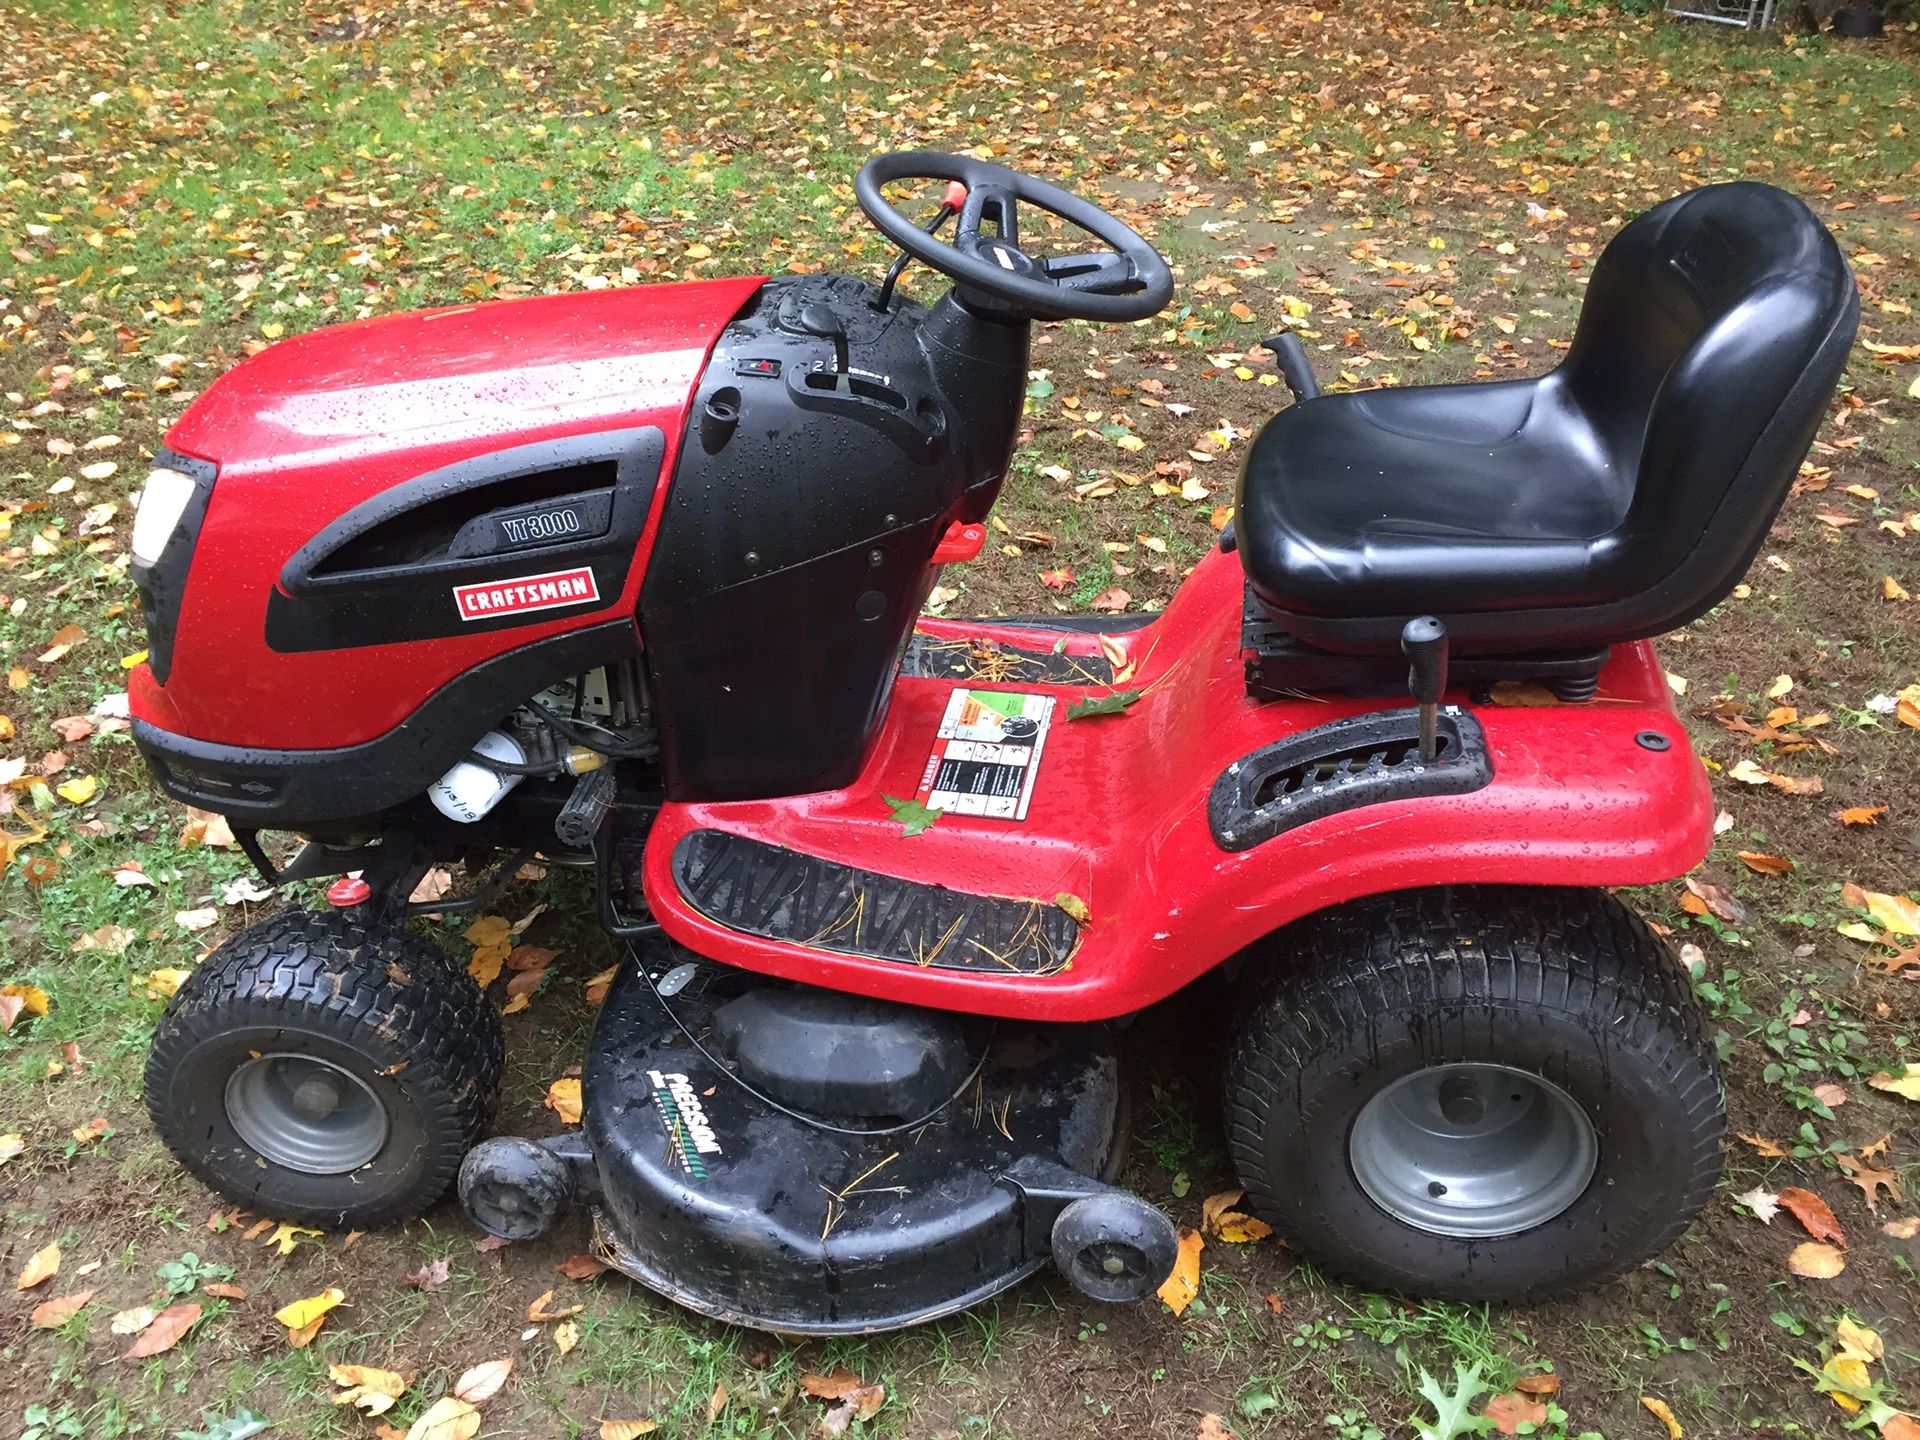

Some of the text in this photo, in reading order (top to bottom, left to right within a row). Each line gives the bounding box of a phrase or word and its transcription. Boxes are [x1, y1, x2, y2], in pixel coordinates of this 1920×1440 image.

[502, 509, 580, 542] YT 3000
[464, 576, 588, 612] CRAFTSMAN
[664, 1073, 722, 1154] PRECISION
